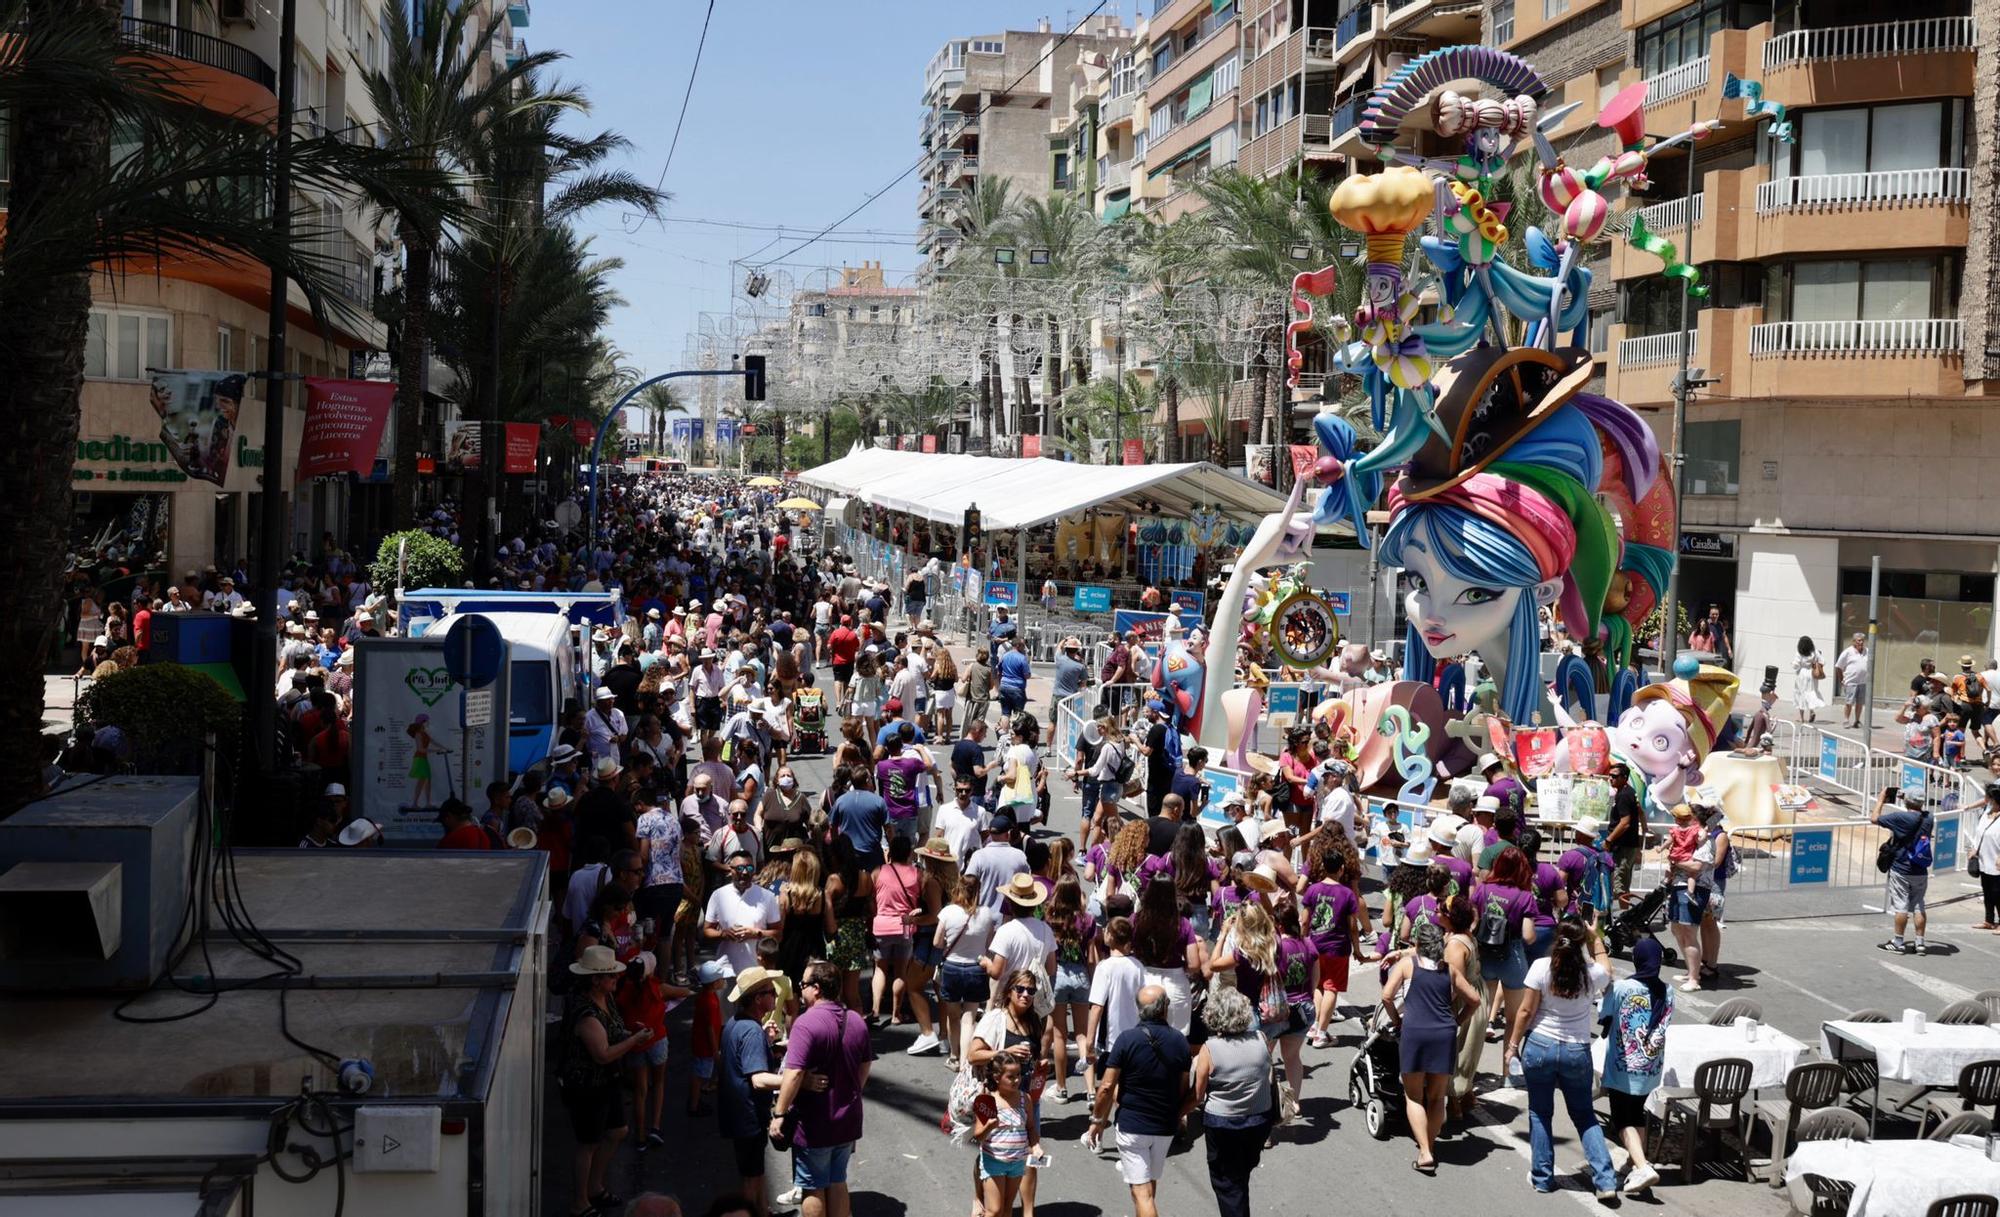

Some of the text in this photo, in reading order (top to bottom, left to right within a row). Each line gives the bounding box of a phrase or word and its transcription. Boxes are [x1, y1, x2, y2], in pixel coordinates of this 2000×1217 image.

[329, 392, 358, 402] Estas
[316, 401, 369, 413] Hogueras
[324, 411, 374, 423] volvemos
[317, 421, 369, 431] encontrar
[320, 430, 361, 440] Luceros
[1690, 537, 1720, 550] CaixaBank
[1796, 839, 1806, 855] E
